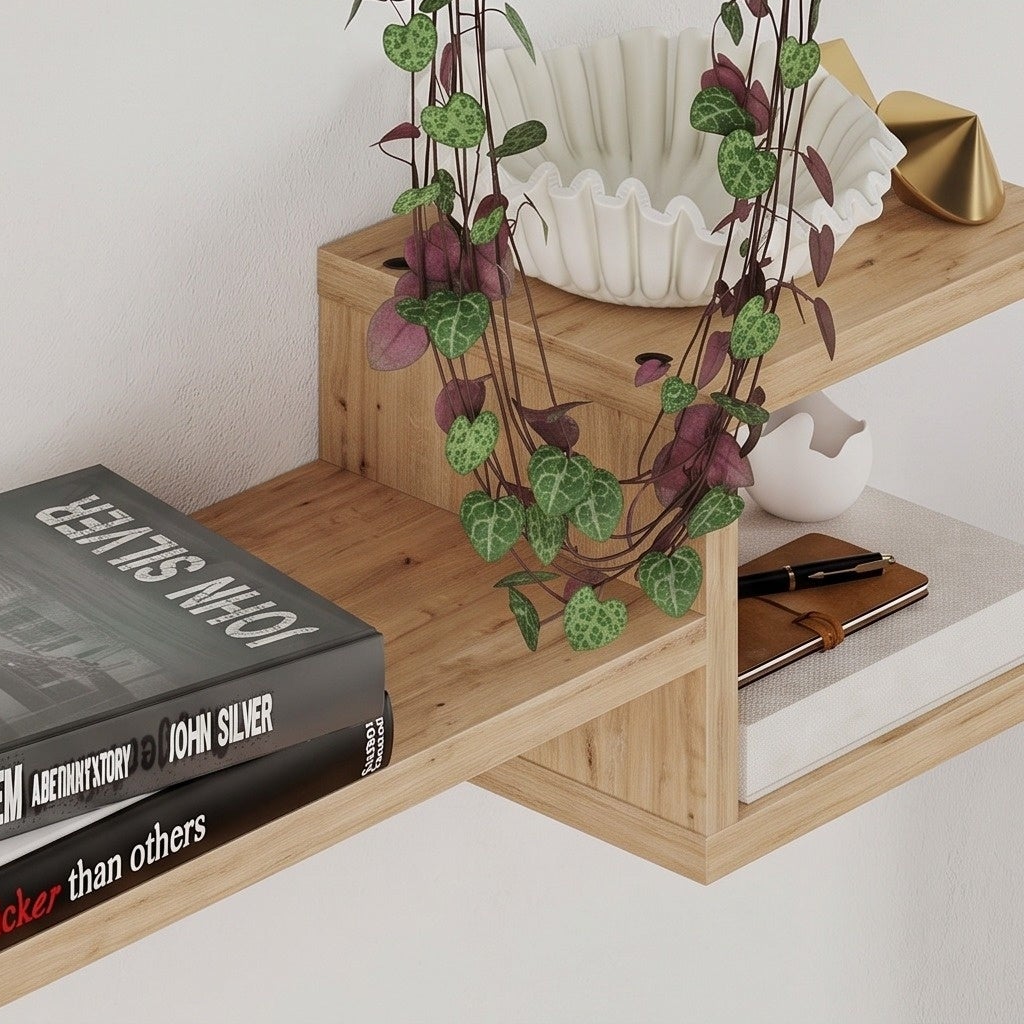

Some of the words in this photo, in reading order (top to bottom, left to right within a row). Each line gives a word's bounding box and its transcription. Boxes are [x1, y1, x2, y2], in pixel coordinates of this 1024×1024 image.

[35, 494, 206, 583] SILVER
[165, 576, 320, 649] JOHN
[169, 711, 212, 763] JOHN
[217, 692, 274, 747] SILVER
[68, 854, 123, 901] than
[130, 814, 207, 872] others
